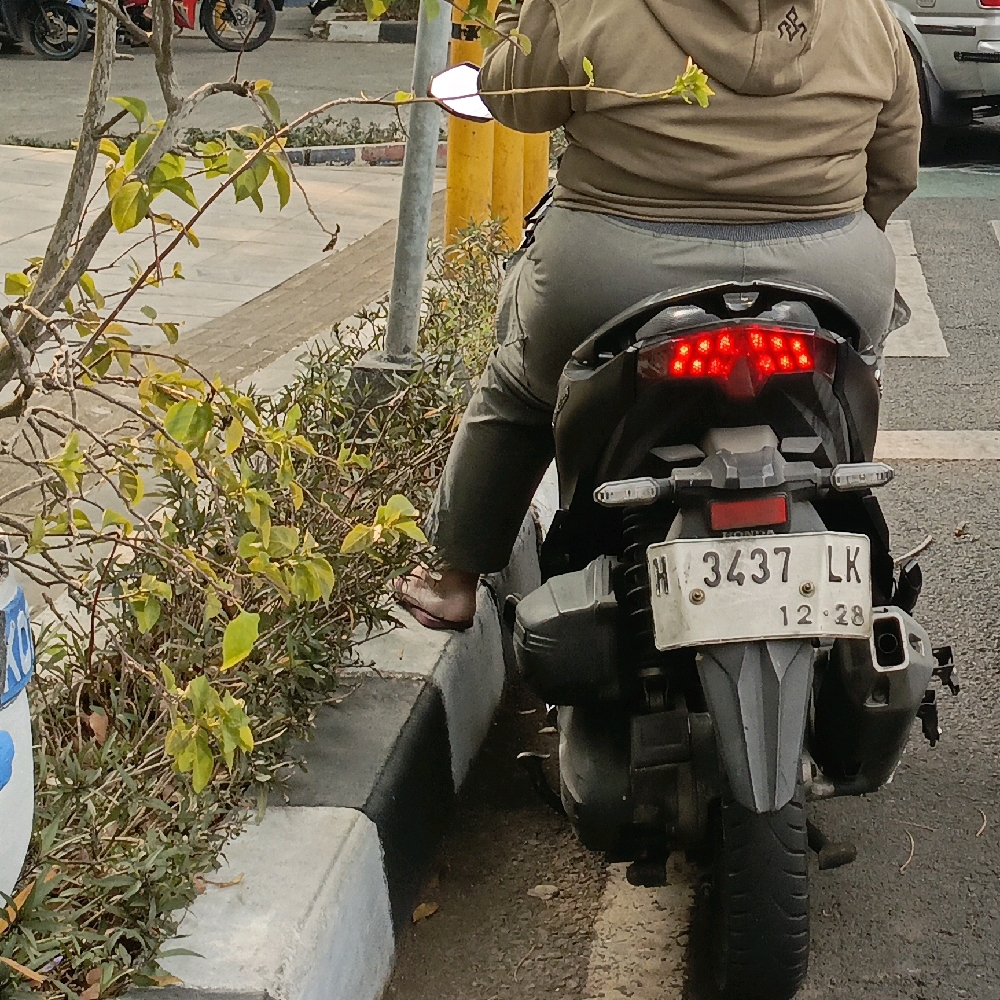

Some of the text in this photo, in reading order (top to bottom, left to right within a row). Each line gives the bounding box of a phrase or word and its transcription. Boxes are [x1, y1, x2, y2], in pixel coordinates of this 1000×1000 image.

[722, 529, 776, 539] HONDA
[702, 546, 792, 588] 3437
[827, 545, 862, 584] LK
